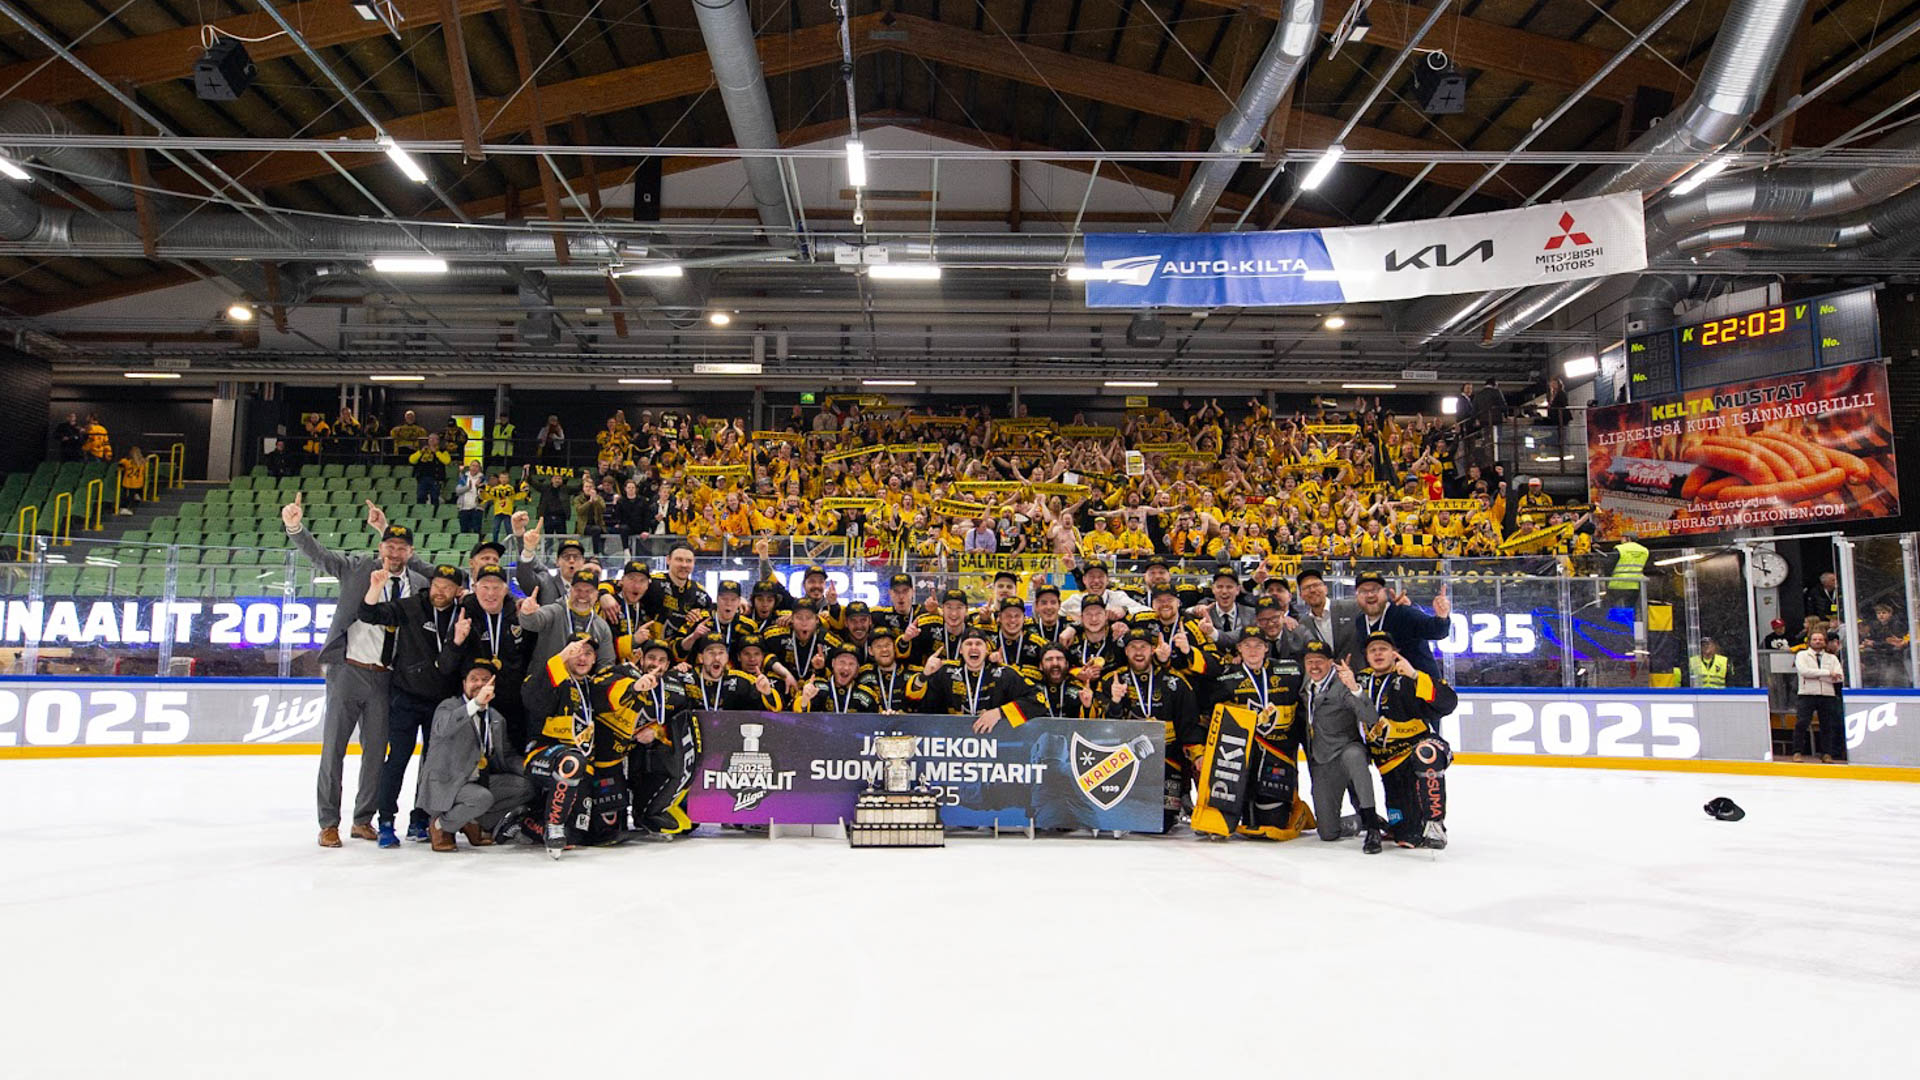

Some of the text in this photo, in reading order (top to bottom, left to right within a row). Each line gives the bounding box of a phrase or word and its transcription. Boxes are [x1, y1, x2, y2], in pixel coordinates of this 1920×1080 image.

[1535, 247, 1603, 265] MITSUBISHI
[1162, 258, 1309, 274] AUTO-KILTA
[1545, 260, 1595, 274] MOTORS
[1794, 305, 1806, 320] V
[1820, 304, 1838, 315] No.
[1682, 328, 1694, 342] K
[1701, 307, 1787, 346] 22:03
[1631, 343, 1646, 353] No.
[1822, 337, 1840, 348] No.
[1633, 373, 1648, 383] No.
[1652, 382, 1805, 421] KELTAMUSTAT
[1598, 392, 1875, 446] LIEKEISSÄ KUIN ISÄNNÄNGRILLI
[535, 465, 573, 477] KALPA
[1432, 501, 1476, 509] KALPA
[1633, 503, 1846, 532] TILATEURASTAMOIKONEN.COM
[1491, 702, 1700, 759] 2025
[738, 764, 764, 772] 2025
[811, 760, 1047, 784] SUOMN MESTARIT
[1085, 751, 1130, 787] KALPA
[1211, 733, 1246, 802] PIKI
[703, 769, 797, 790] FINAALIT
[1101, 785, 1120, 793] 1929
[1426, 768, 1442, 819] OSUMA
[549, 781, 569, 824] OSUMA
[733, 790, 767, 812] Liiga
